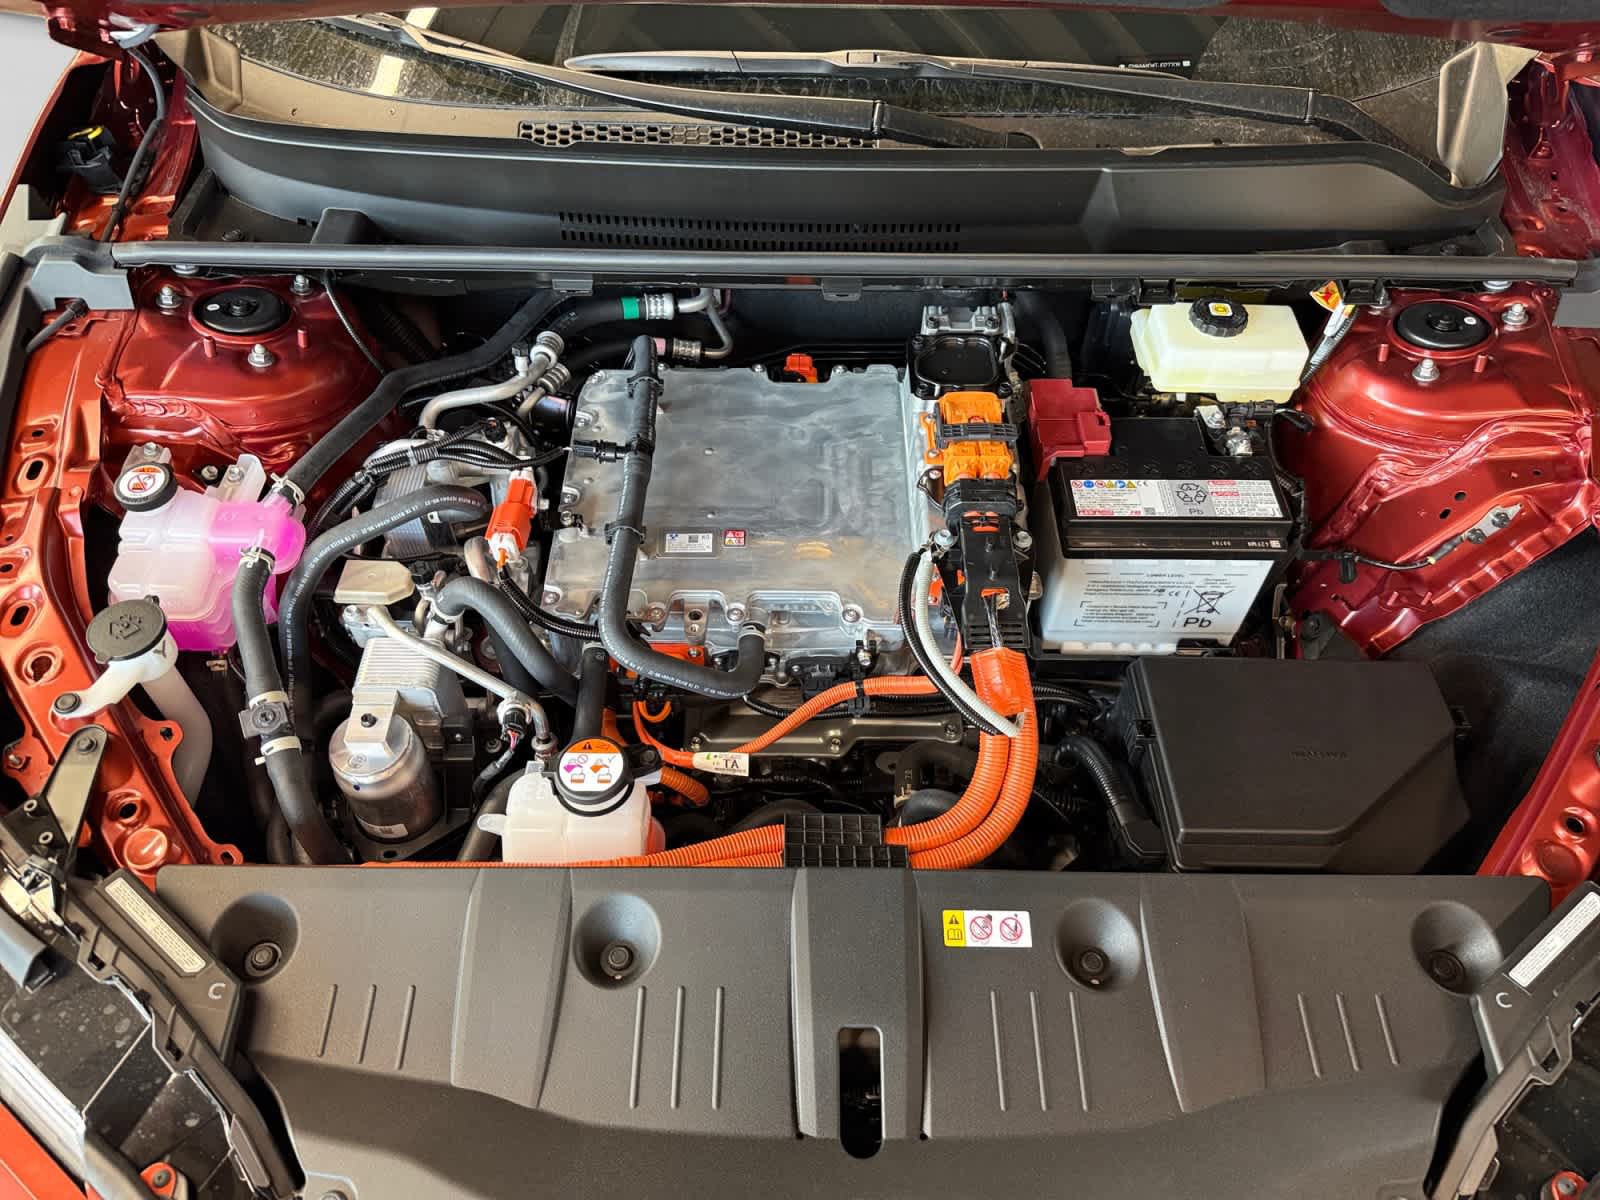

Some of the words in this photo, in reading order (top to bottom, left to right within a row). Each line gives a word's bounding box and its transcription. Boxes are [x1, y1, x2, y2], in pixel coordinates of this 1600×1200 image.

[1184, 617, 1212, 628] Pb
[723, 759, 739, 769] TA
[207, 982, 226, 1000] C
[1496, 992, 1513, 1008] C
